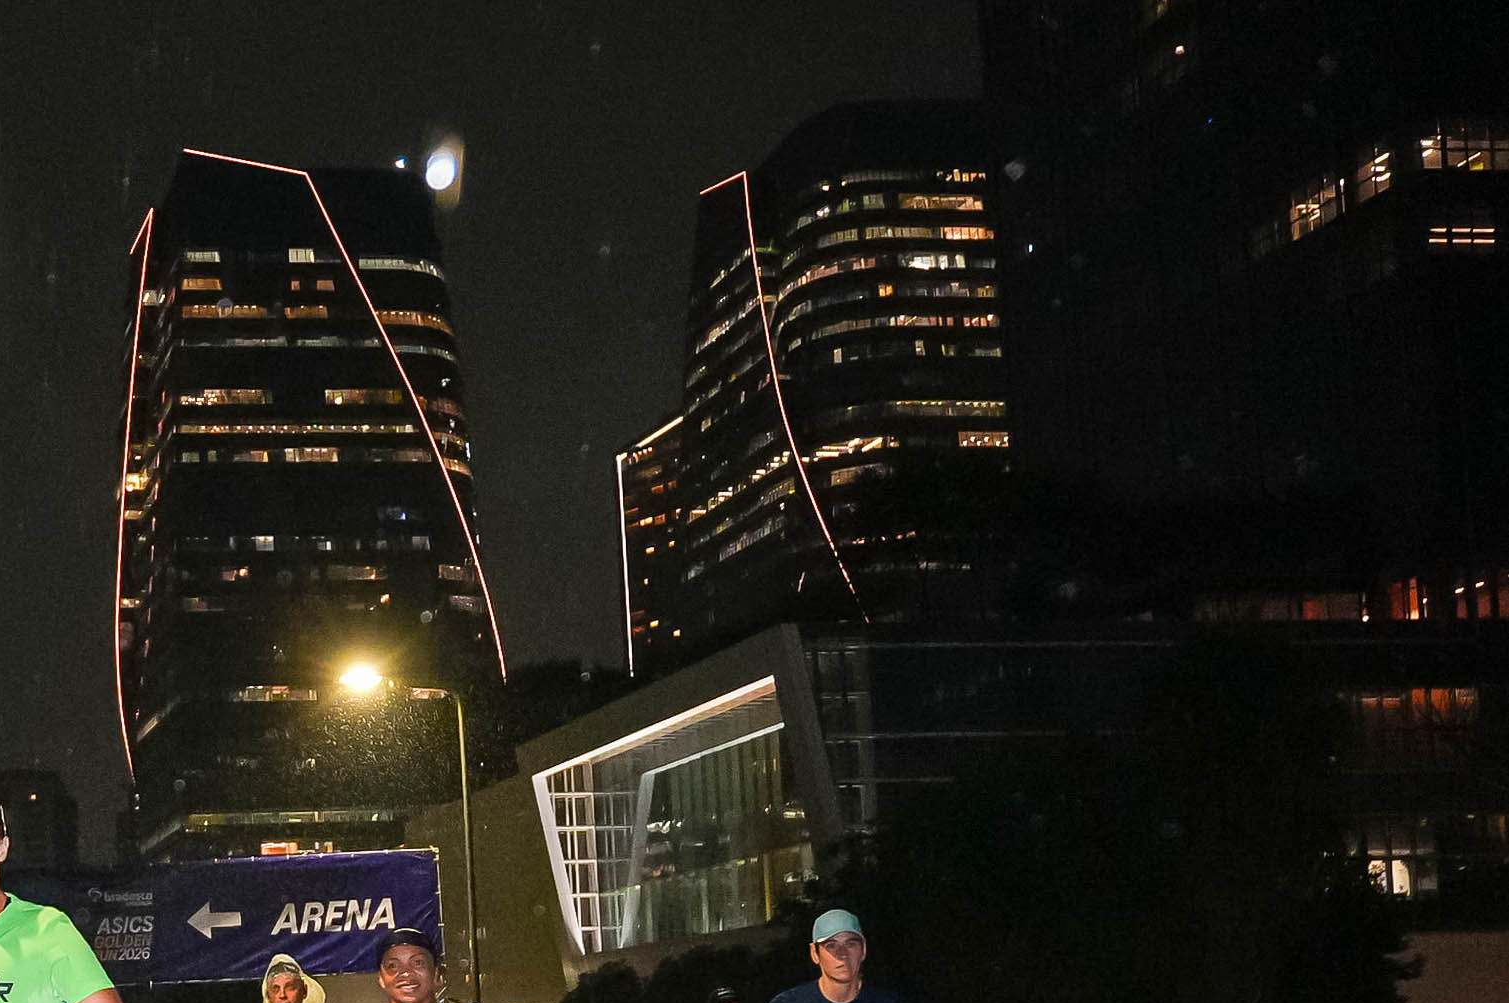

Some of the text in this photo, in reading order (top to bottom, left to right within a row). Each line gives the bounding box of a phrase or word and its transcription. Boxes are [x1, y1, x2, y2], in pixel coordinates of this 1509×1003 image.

[97, 915, 155, 935] ASICS
[271, 898, 396, 936] ARENA
[94, 934, 152, 949] GOLDEN
[118, 946, 151, 961] 2026
